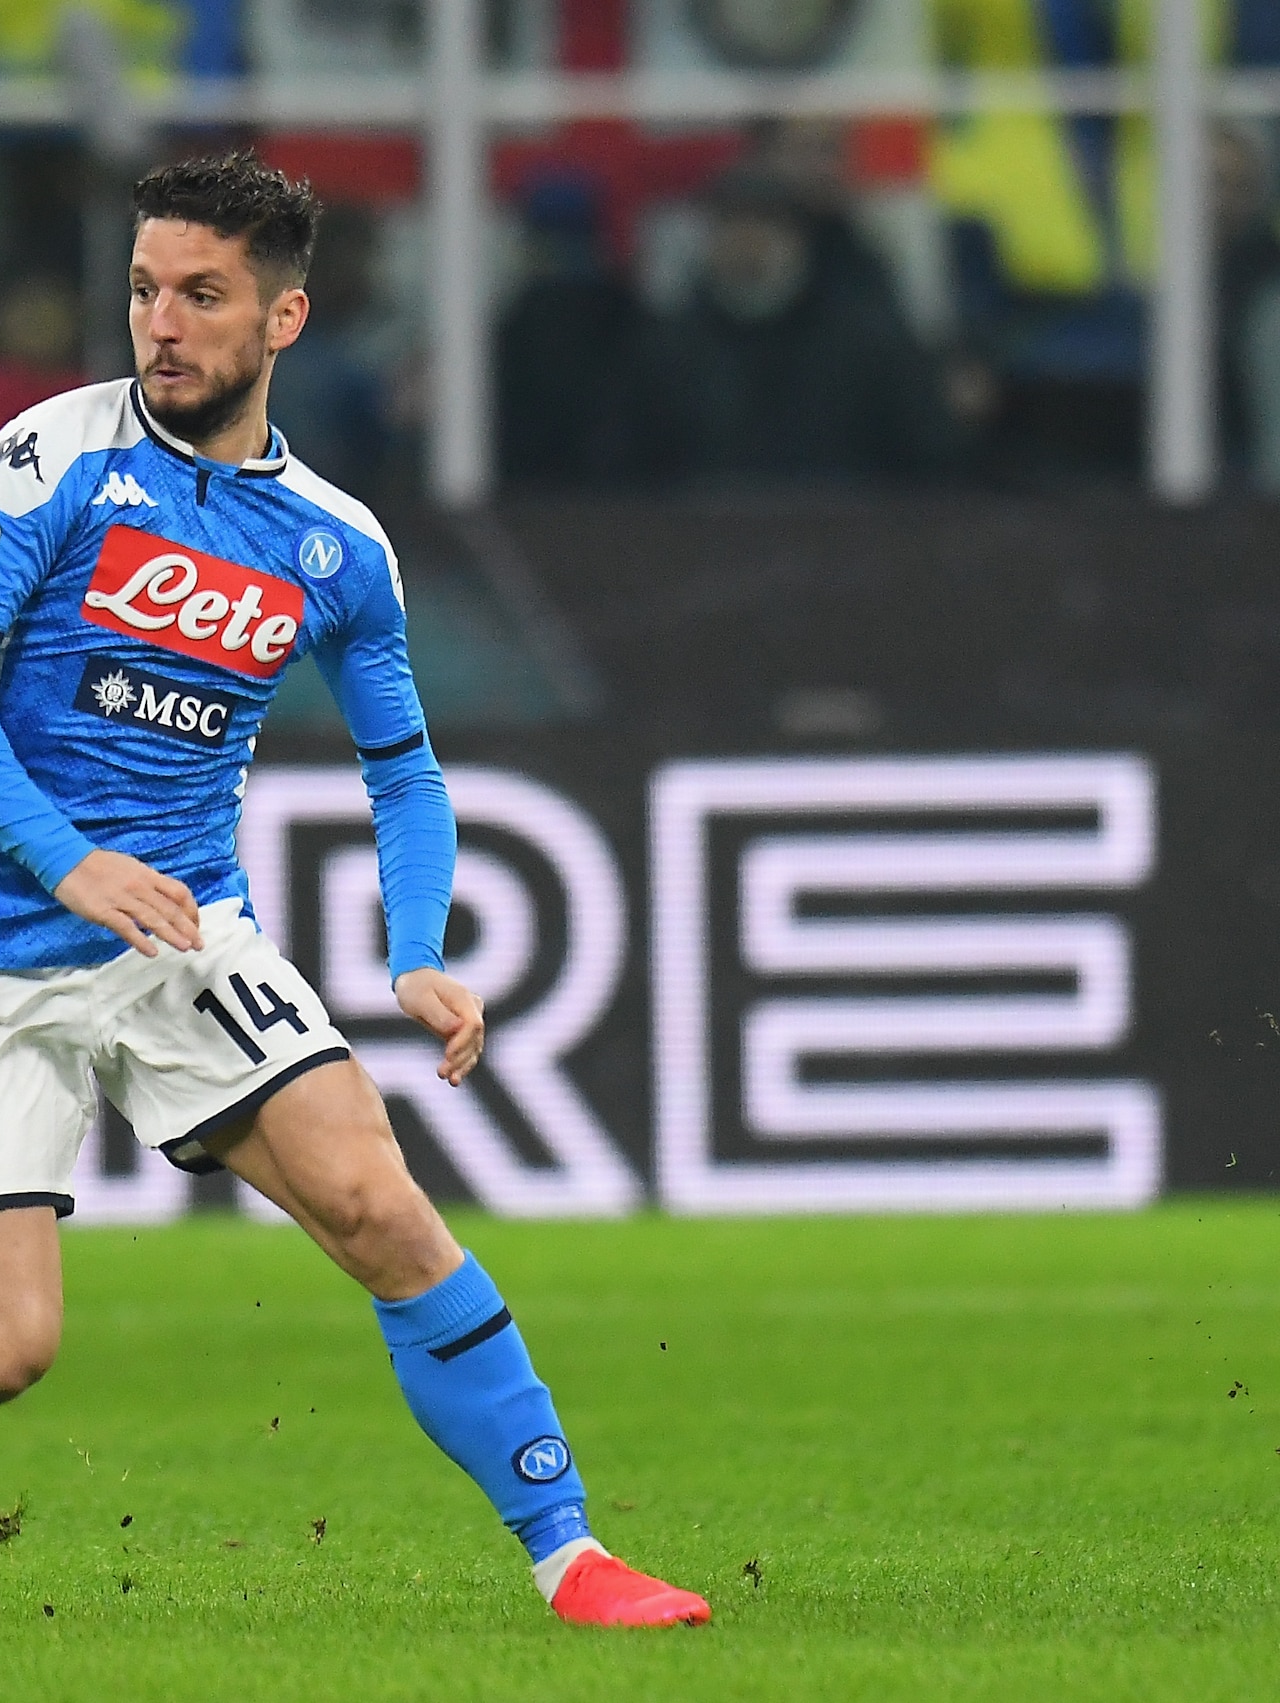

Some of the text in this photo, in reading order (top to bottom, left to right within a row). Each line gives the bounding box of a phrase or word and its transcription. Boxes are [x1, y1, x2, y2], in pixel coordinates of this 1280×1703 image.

[305, 539, 337, 572] N
[85, 552, 298, 664] Lete
[134, 683, 227, 738] MSC
[193, 972, 309, 1066] 14
[532, 1445, 558, 1474] N
